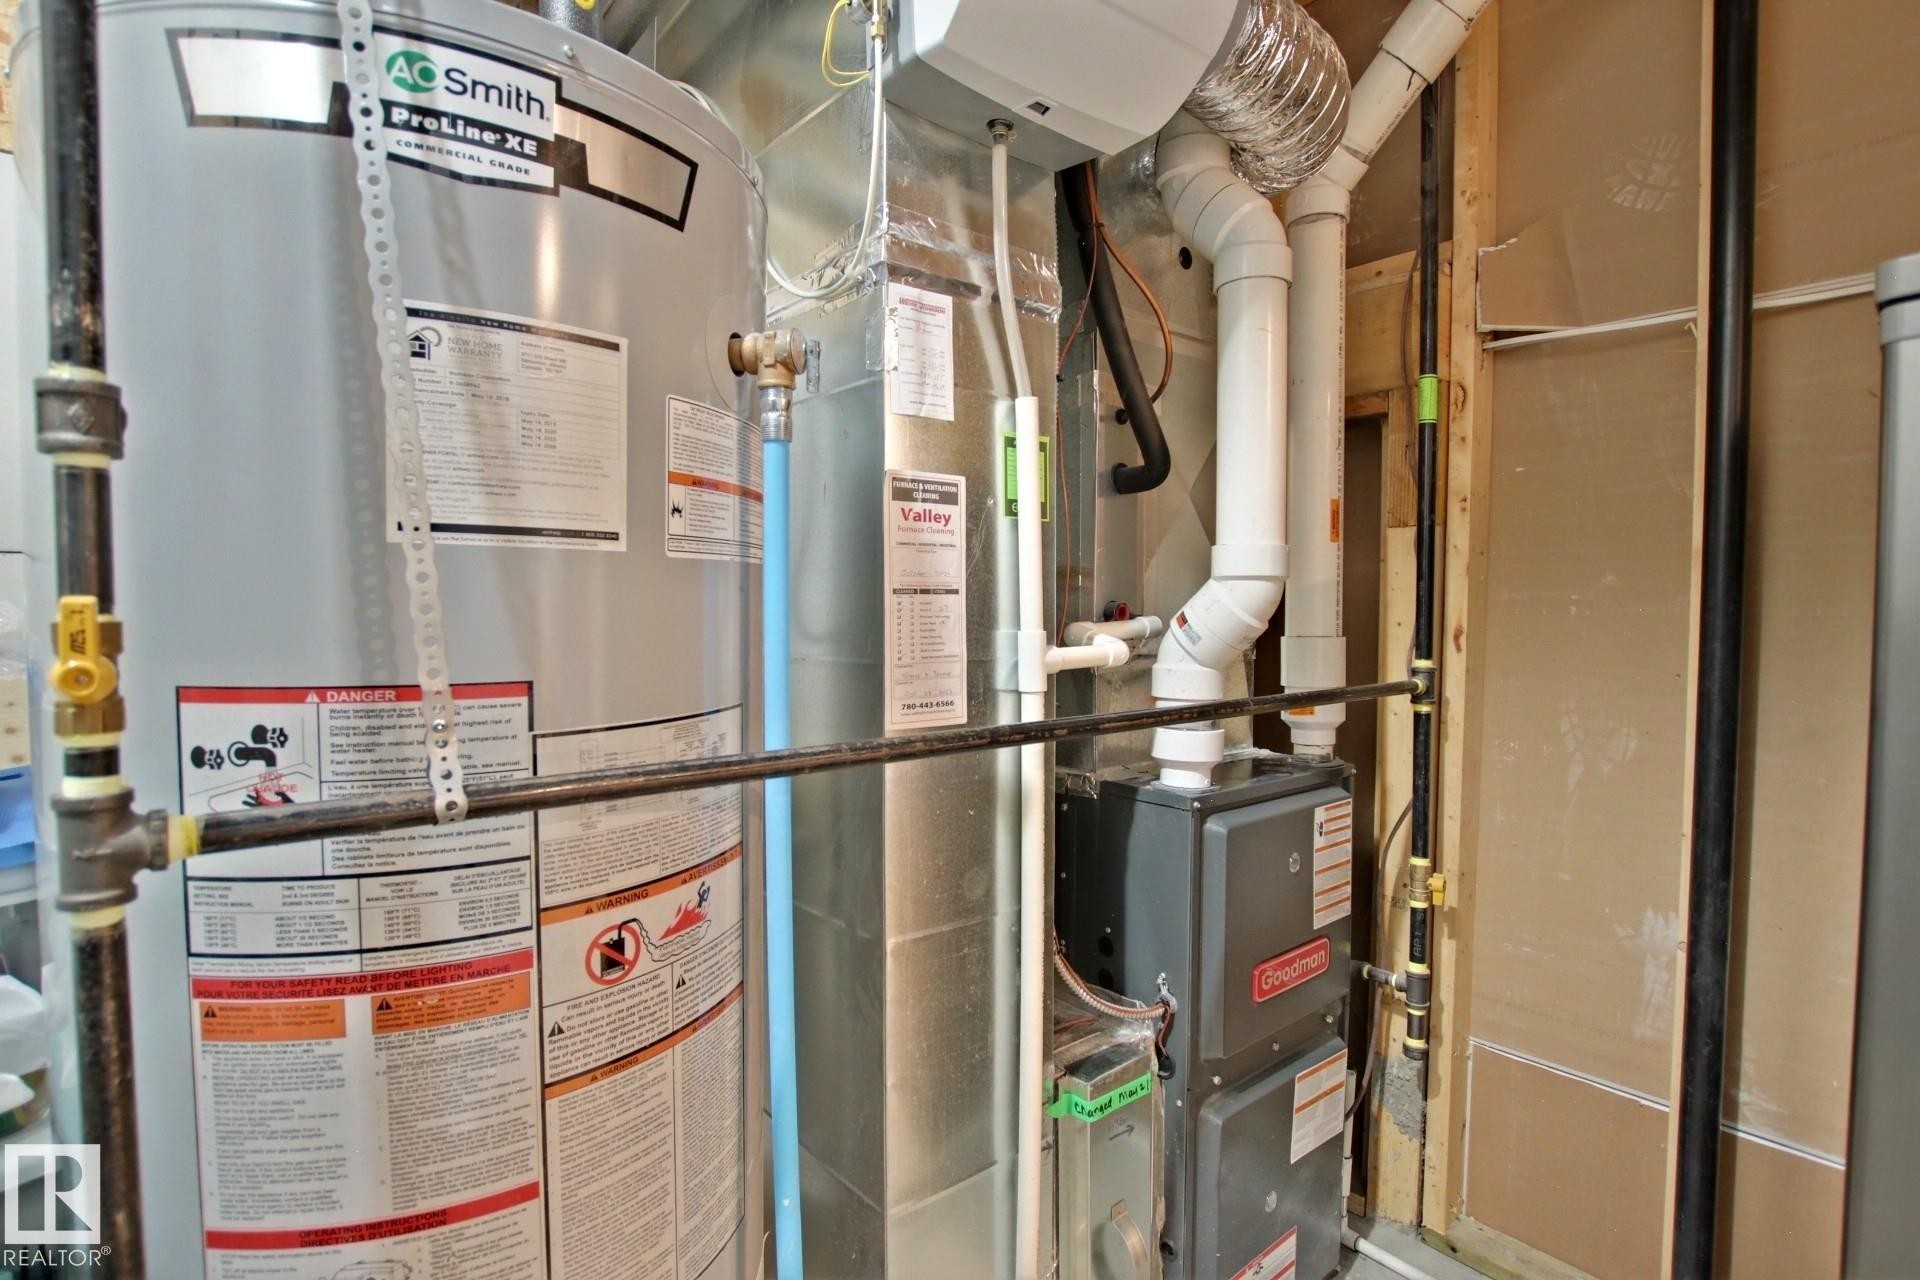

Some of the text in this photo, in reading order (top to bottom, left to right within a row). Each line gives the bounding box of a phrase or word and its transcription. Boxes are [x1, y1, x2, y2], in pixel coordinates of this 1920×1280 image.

[444, 68, 544, 119] Smith
[504, 133, 538, 156] XE
[396, 139, 530, 176] COMMERCIAL GRADE
[447, 337, 503, 352] NEW HOME
[447, 345, 503, 361] WARRANTY
[892, 481, 958, 496] FURNACE & VENTILATION
[913, 492, 940, 500] CLEANING
[900, 507, 952, 527] Valley
[926, 526, 955, 536] Cleaning
[327, 690, 397, 702] DANGER
[901, 699, 955, 711] 780-443-6566
[366, 723, 397, 731] disabled
[346, 741, 386, 749] instruction
[364, 836, 406, 844] température
[417, 846, 457, 856] température
[597, 888, 649, 911] WARNING
[231, 980, 254, 990] FOR
[255, 978, 287, 989] YOUR
[288, 976, 333, 988] SAFETY
[335, 974, 368, 986] READ
[370, 971, 417, 984] BEFORE
[419, 962, 473, 980] LIGHTING
[1262, 950, 1326, 990] Goodman
[196, 989, 221, 999] POUR
[222, 989, 258, 999] VOTRE
[315, 986, 346, 998] LISEZ
[347, 983, 384, 996] AVANT
[386, 982, 402, 992] DE
[404, 976, 447, 991] METTRE
[450, 974, 465, 984] EN
[467, 965, 511, 982] MARCHE
[567, 1001, 583, 1011] FIRE
[584, 997, 600, 1008] AND
[600, 984, 637, 1002] EXPLOSION
[562, 1011, 577, 1022] Can
[578, 1008, 596, 1018] result
[567, 1024, 577, 1032] Do
[578, 1020, 588, 1029] not
[588, 1015, 606, 1026] store
[583, 1025, 605, 1037] vapors
[605, 1021, 617, 1029] and
[617, 1013, 636, 1026] liquids
[549, 1053, 562, 1062] use
[570, 1041, 596, 1056] gasoline
[604, 1033, 619, 1044] other
[556, 1043, 570, 1051] this
[579, 1036, 591, 1047] any
[592, 1030, 609, 1040] other
[549, 1058, 573, 1070] liquids
[582, 1051, 594, 1060] the
[549, 1064, 579, 1079] appliance
[592, 1052, 609, 1063] result
[600, 1056, 640, 1078] WARNING
[1074, 1097, 1113, 1118] Changed
[1118, 1089, 1139, 1104] May
[299, 1209, 448, 1239] OPERATING INSTRUCTIONS
[300, 1219, 447, 1249] DIRECTIVES D'UTILISATION
